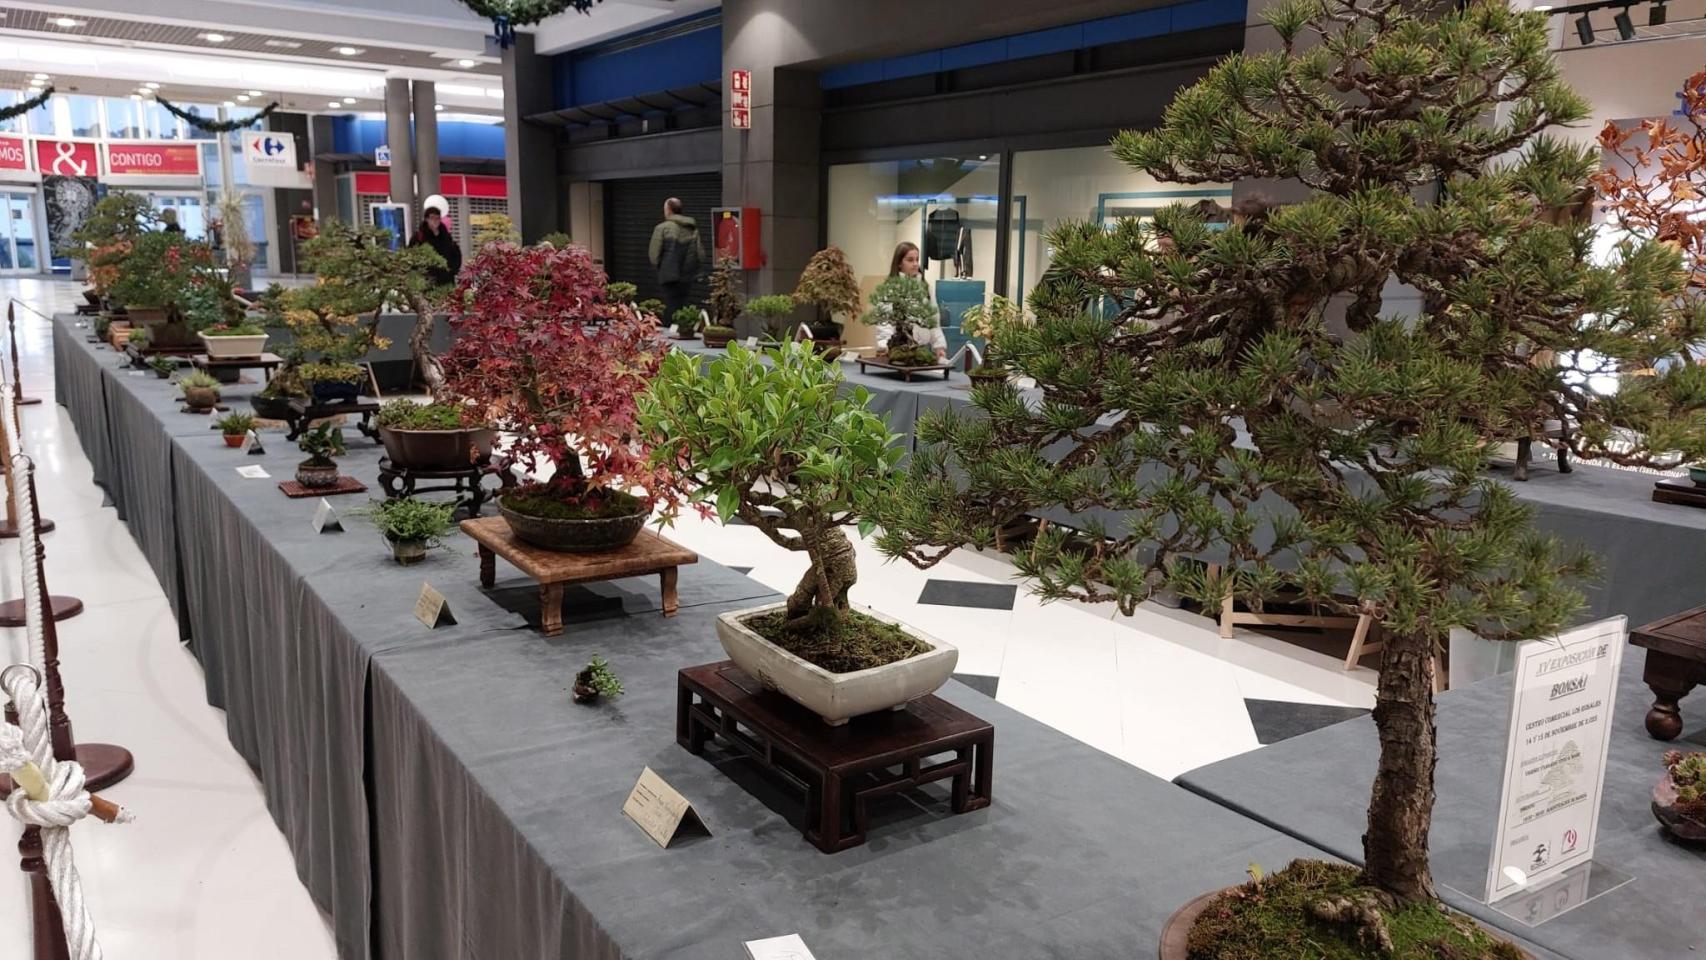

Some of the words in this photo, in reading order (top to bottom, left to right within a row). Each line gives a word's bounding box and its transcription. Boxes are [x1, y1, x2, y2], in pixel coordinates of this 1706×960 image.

[52, 140, 88, 176] &
[110, 152, 162, 167] CONTIGO
[1571, 456, 1602, 467] PRENDA
[1597, 644, 1609, 656] DE
[1525, 718, 1544, 731] CENTRO
[1545, 709, 1570, 724] COMERCIAL
